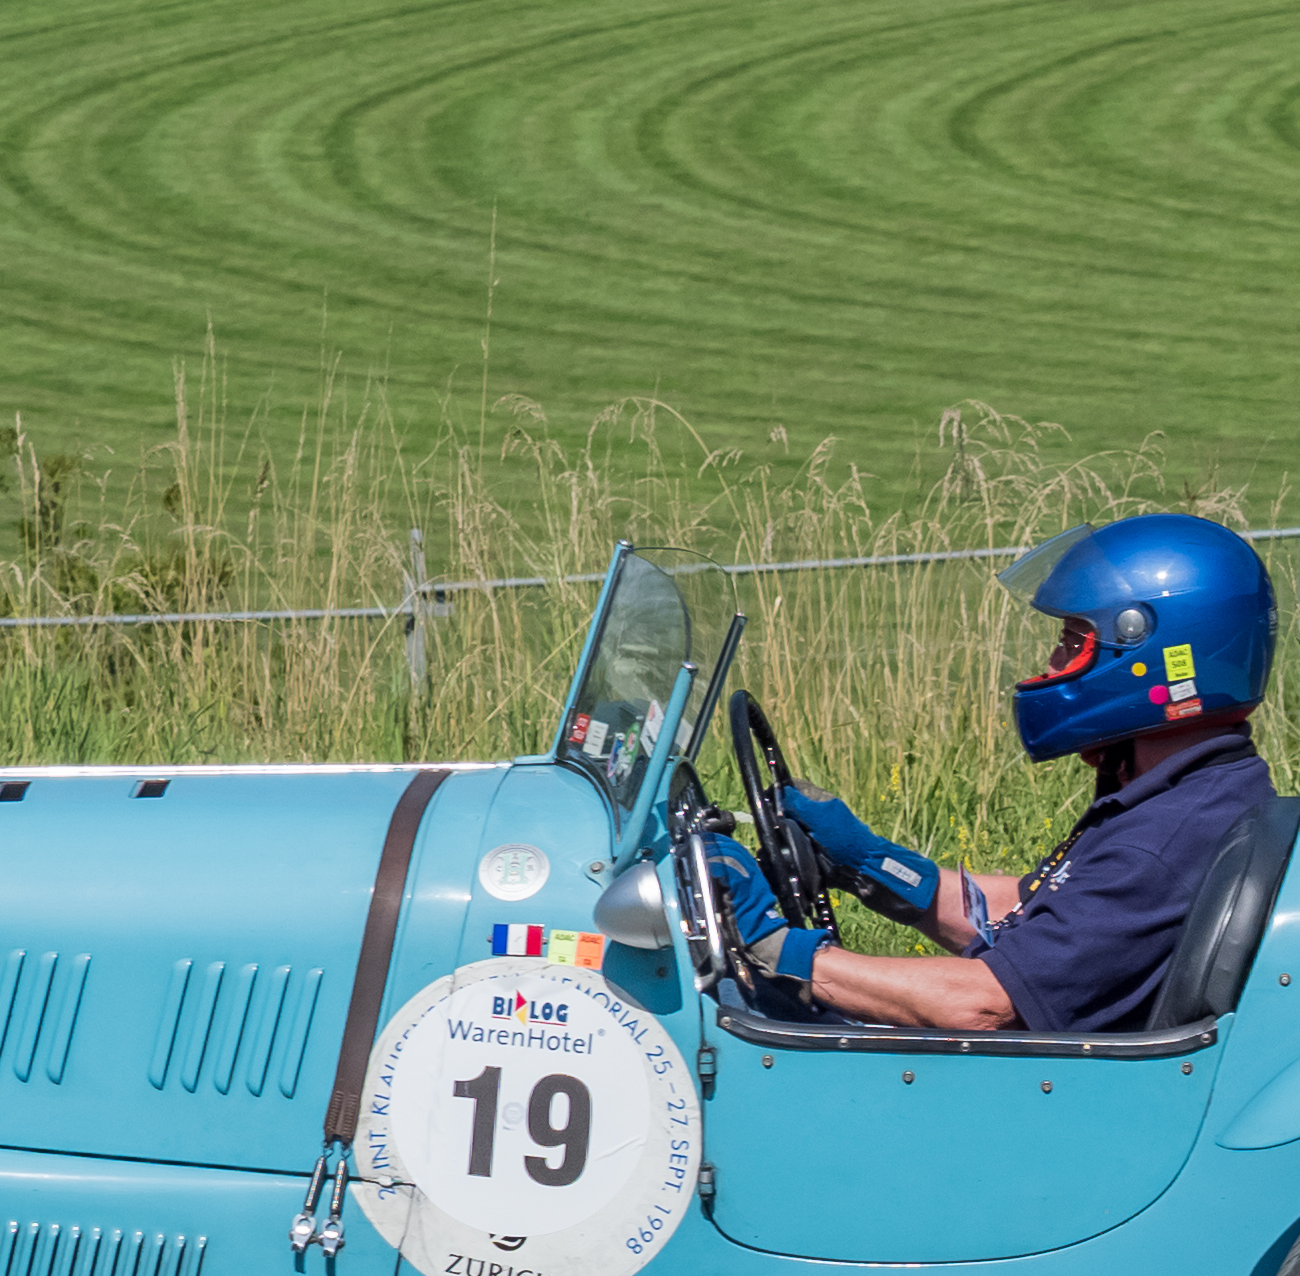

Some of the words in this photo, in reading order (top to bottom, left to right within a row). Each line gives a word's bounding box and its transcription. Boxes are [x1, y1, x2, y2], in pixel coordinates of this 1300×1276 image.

[448, 1019, 593, 1055] WarenHotel
[369, 1127, 390, 1169] INT.
[453, 1065, 592, 1187] 19
[661, 1139, 690, 1193] SEPT.
[625, 1204, 672, 1255] 1998
